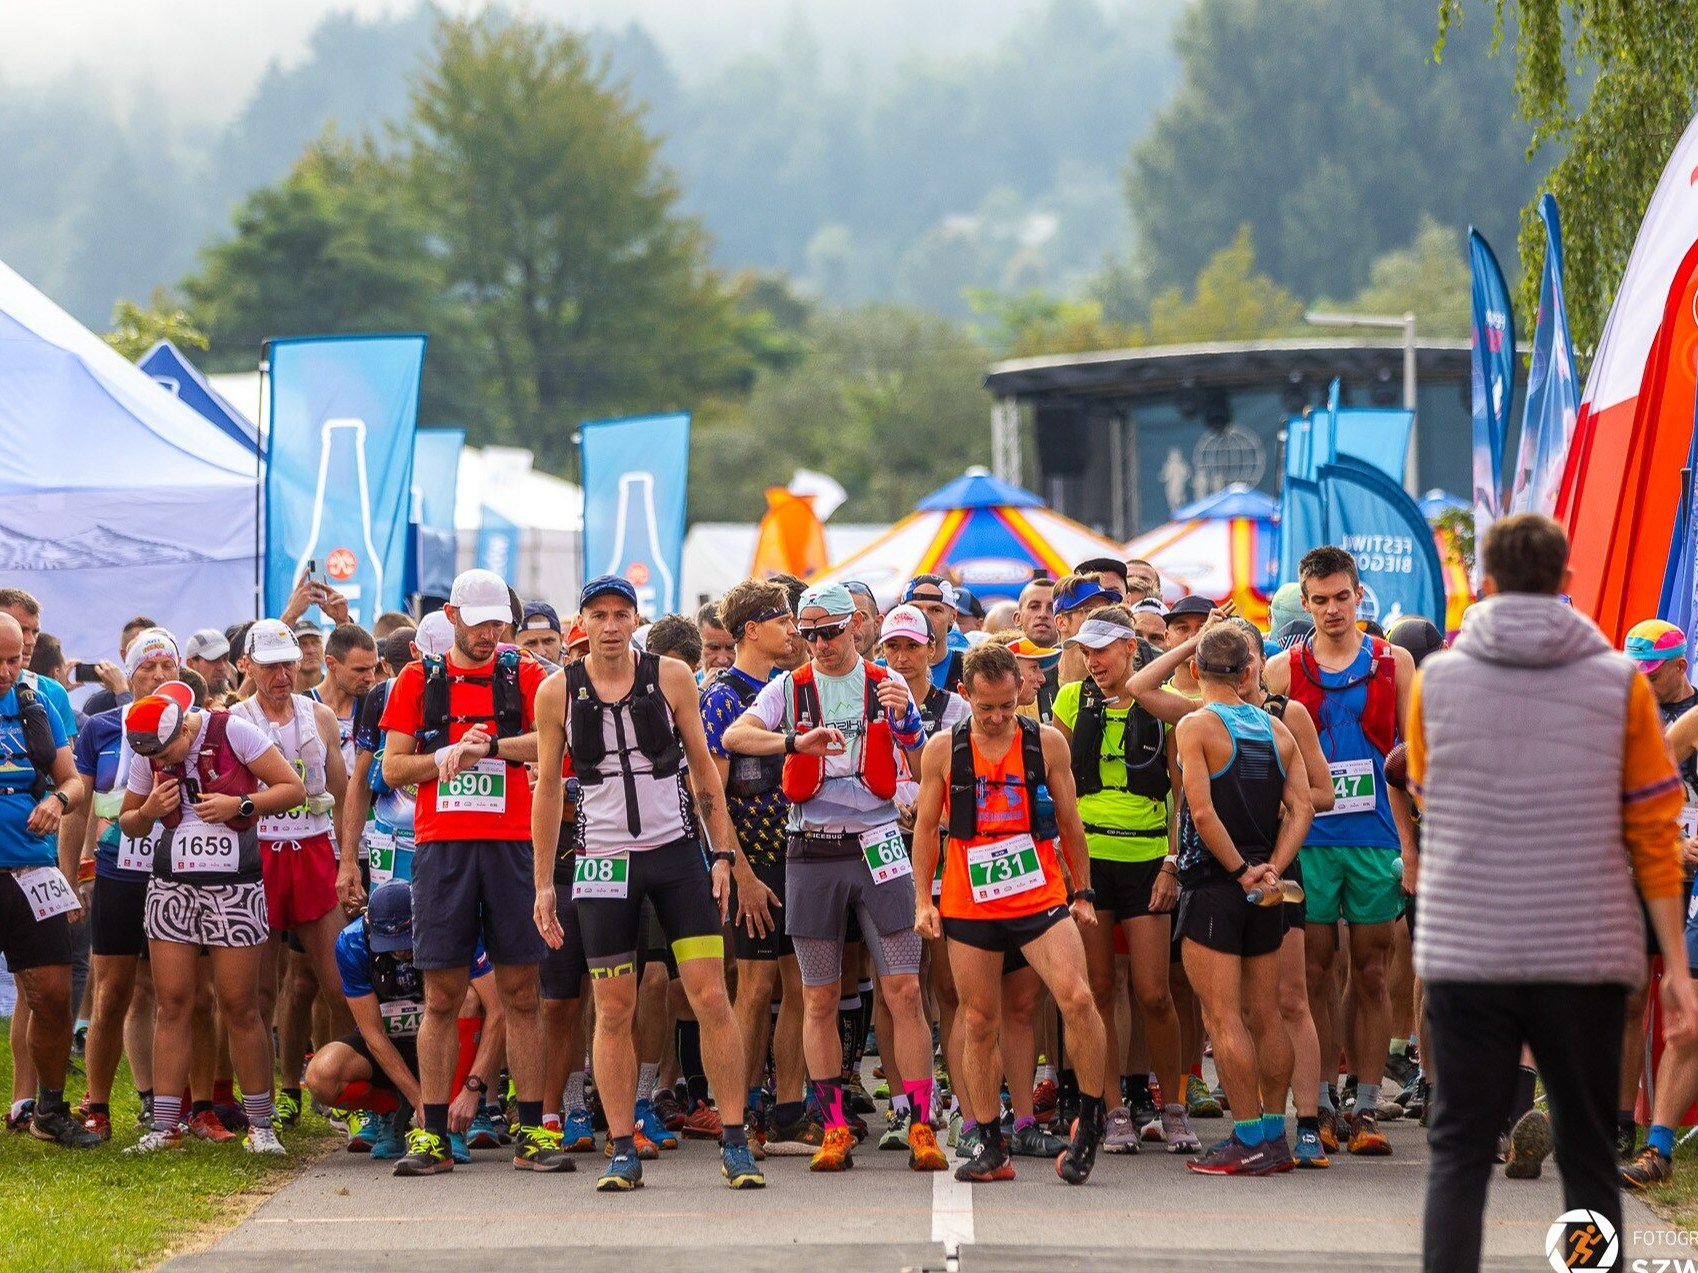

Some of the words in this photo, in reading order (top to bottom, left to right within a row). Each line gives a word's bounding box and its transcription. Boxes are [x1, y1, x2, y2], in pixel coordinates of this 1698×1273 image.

[449, 774, 492, 796] 690
[178, 836, 232, 857] 1659
[812, 832, 843, 840] ICEBUG
[368, 848, 382, 869] 3
[980, 853, 1025, 884] 731
[575, 860, 614, 881] 708
[30, 878, 69, 904] 1754
